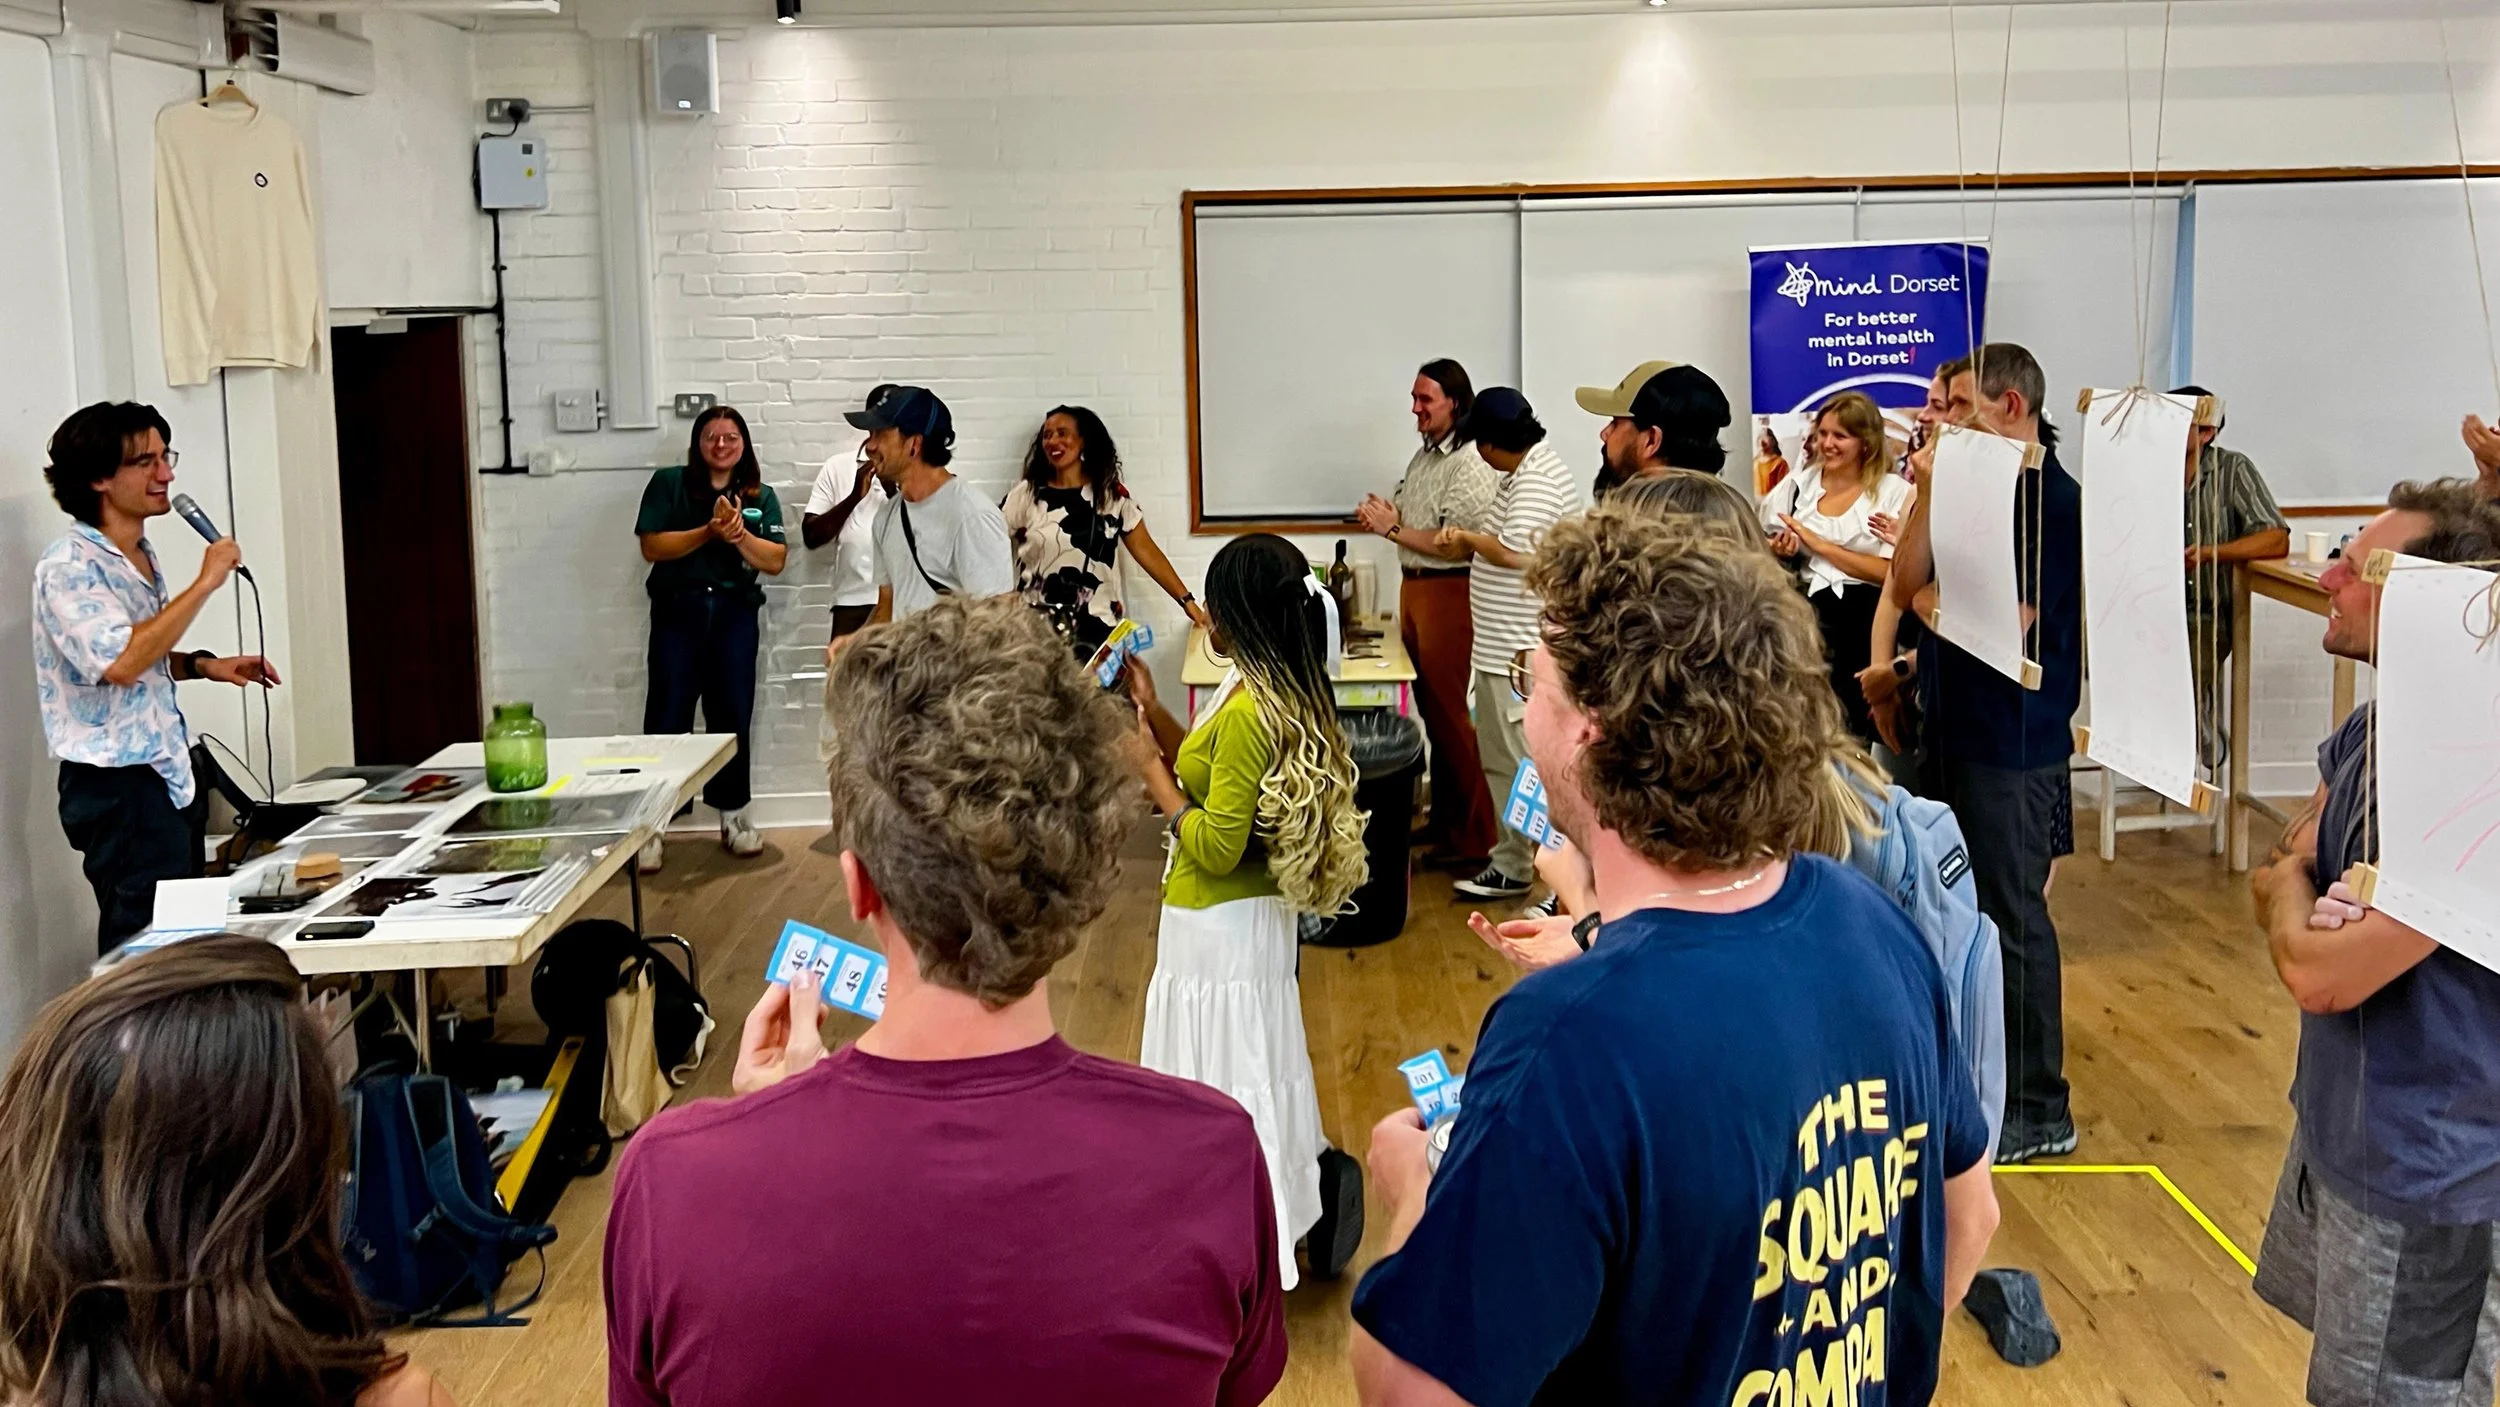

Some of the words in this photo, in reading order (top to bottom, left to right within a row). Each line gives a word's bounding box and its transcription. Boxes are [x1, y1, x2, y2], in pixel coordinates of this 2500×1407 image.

[1814, 274, 1882, 297] mind
[1890, 274, 1960, 294] Dorset
[1824, 313, 1853, 328] For
[1857, 311, 1917, 326] better
[1808, 331, 1872, 348] mental
[1876, 328, 1935, 346] health
[1827, 352, 1844, 367] in
[1798, 1078, 1890, 1174] THE
[1753, 1122, 1929, 1302] SQUARE
[1801, 1257, 1890, 1336] AND
